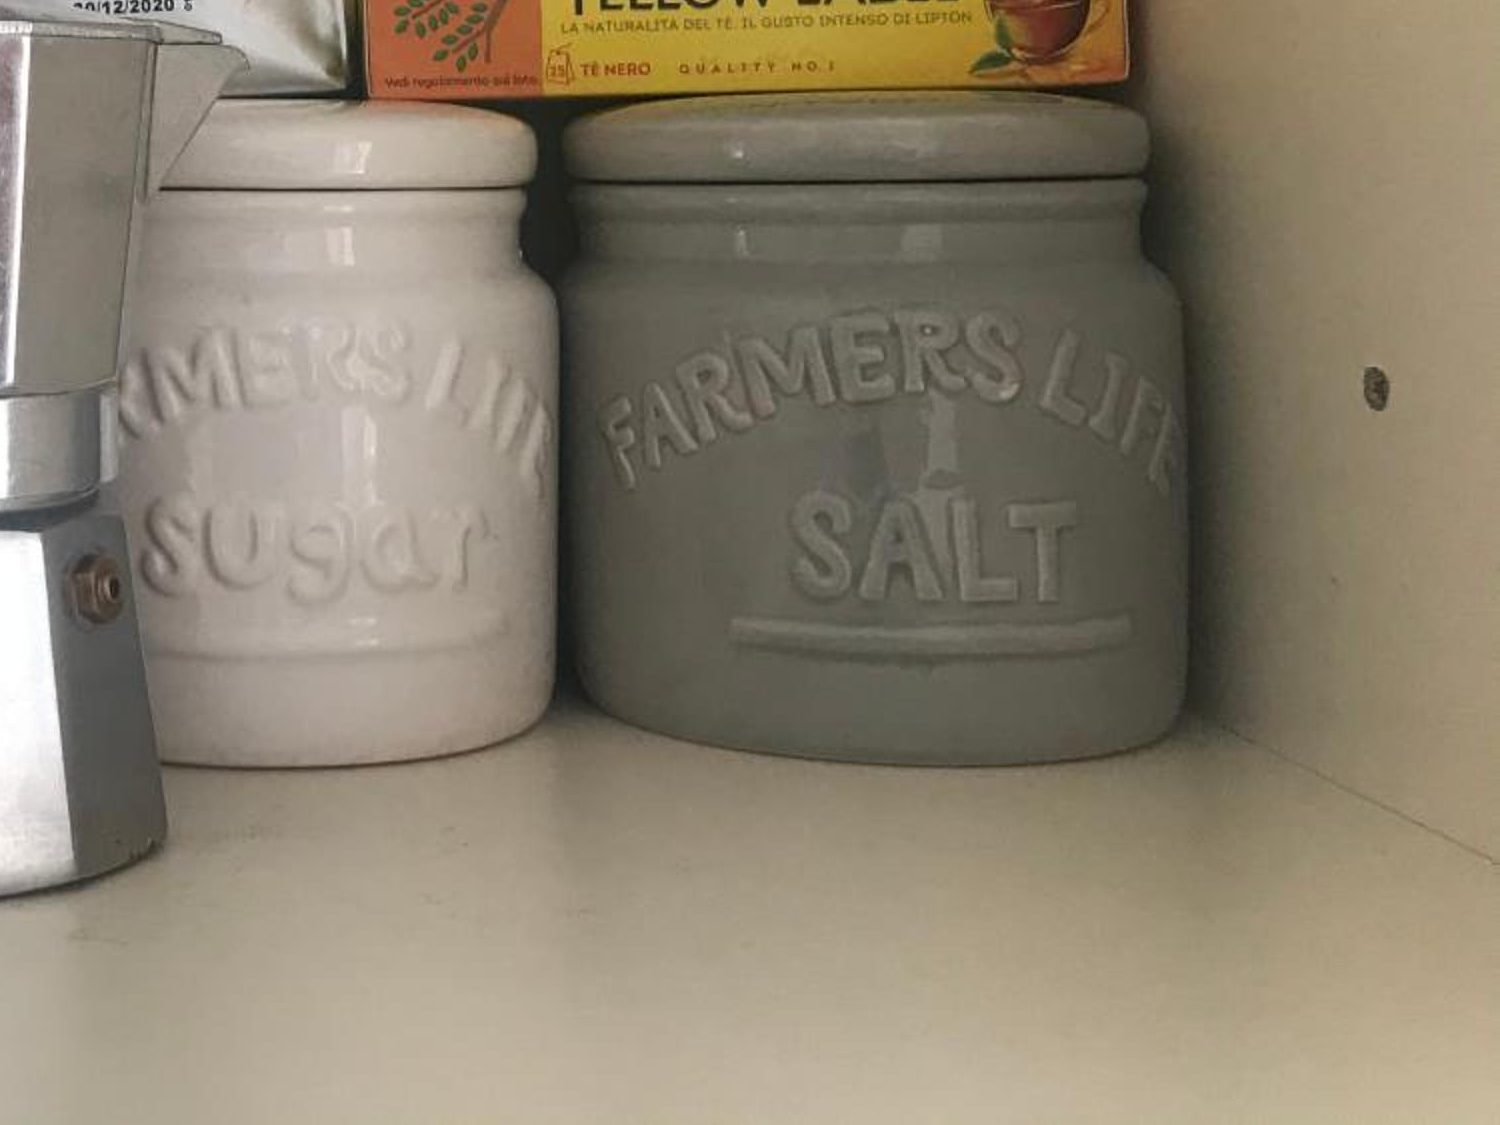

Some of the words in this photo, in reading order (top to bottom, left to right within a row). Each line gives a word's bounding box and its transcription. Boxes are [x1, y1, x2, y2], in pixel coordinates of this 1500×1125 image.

[604, 62, 652, 76] NERO
[604, 309, 1021, 489] FARMERS
[789, 489, 1078, 604] SALT
